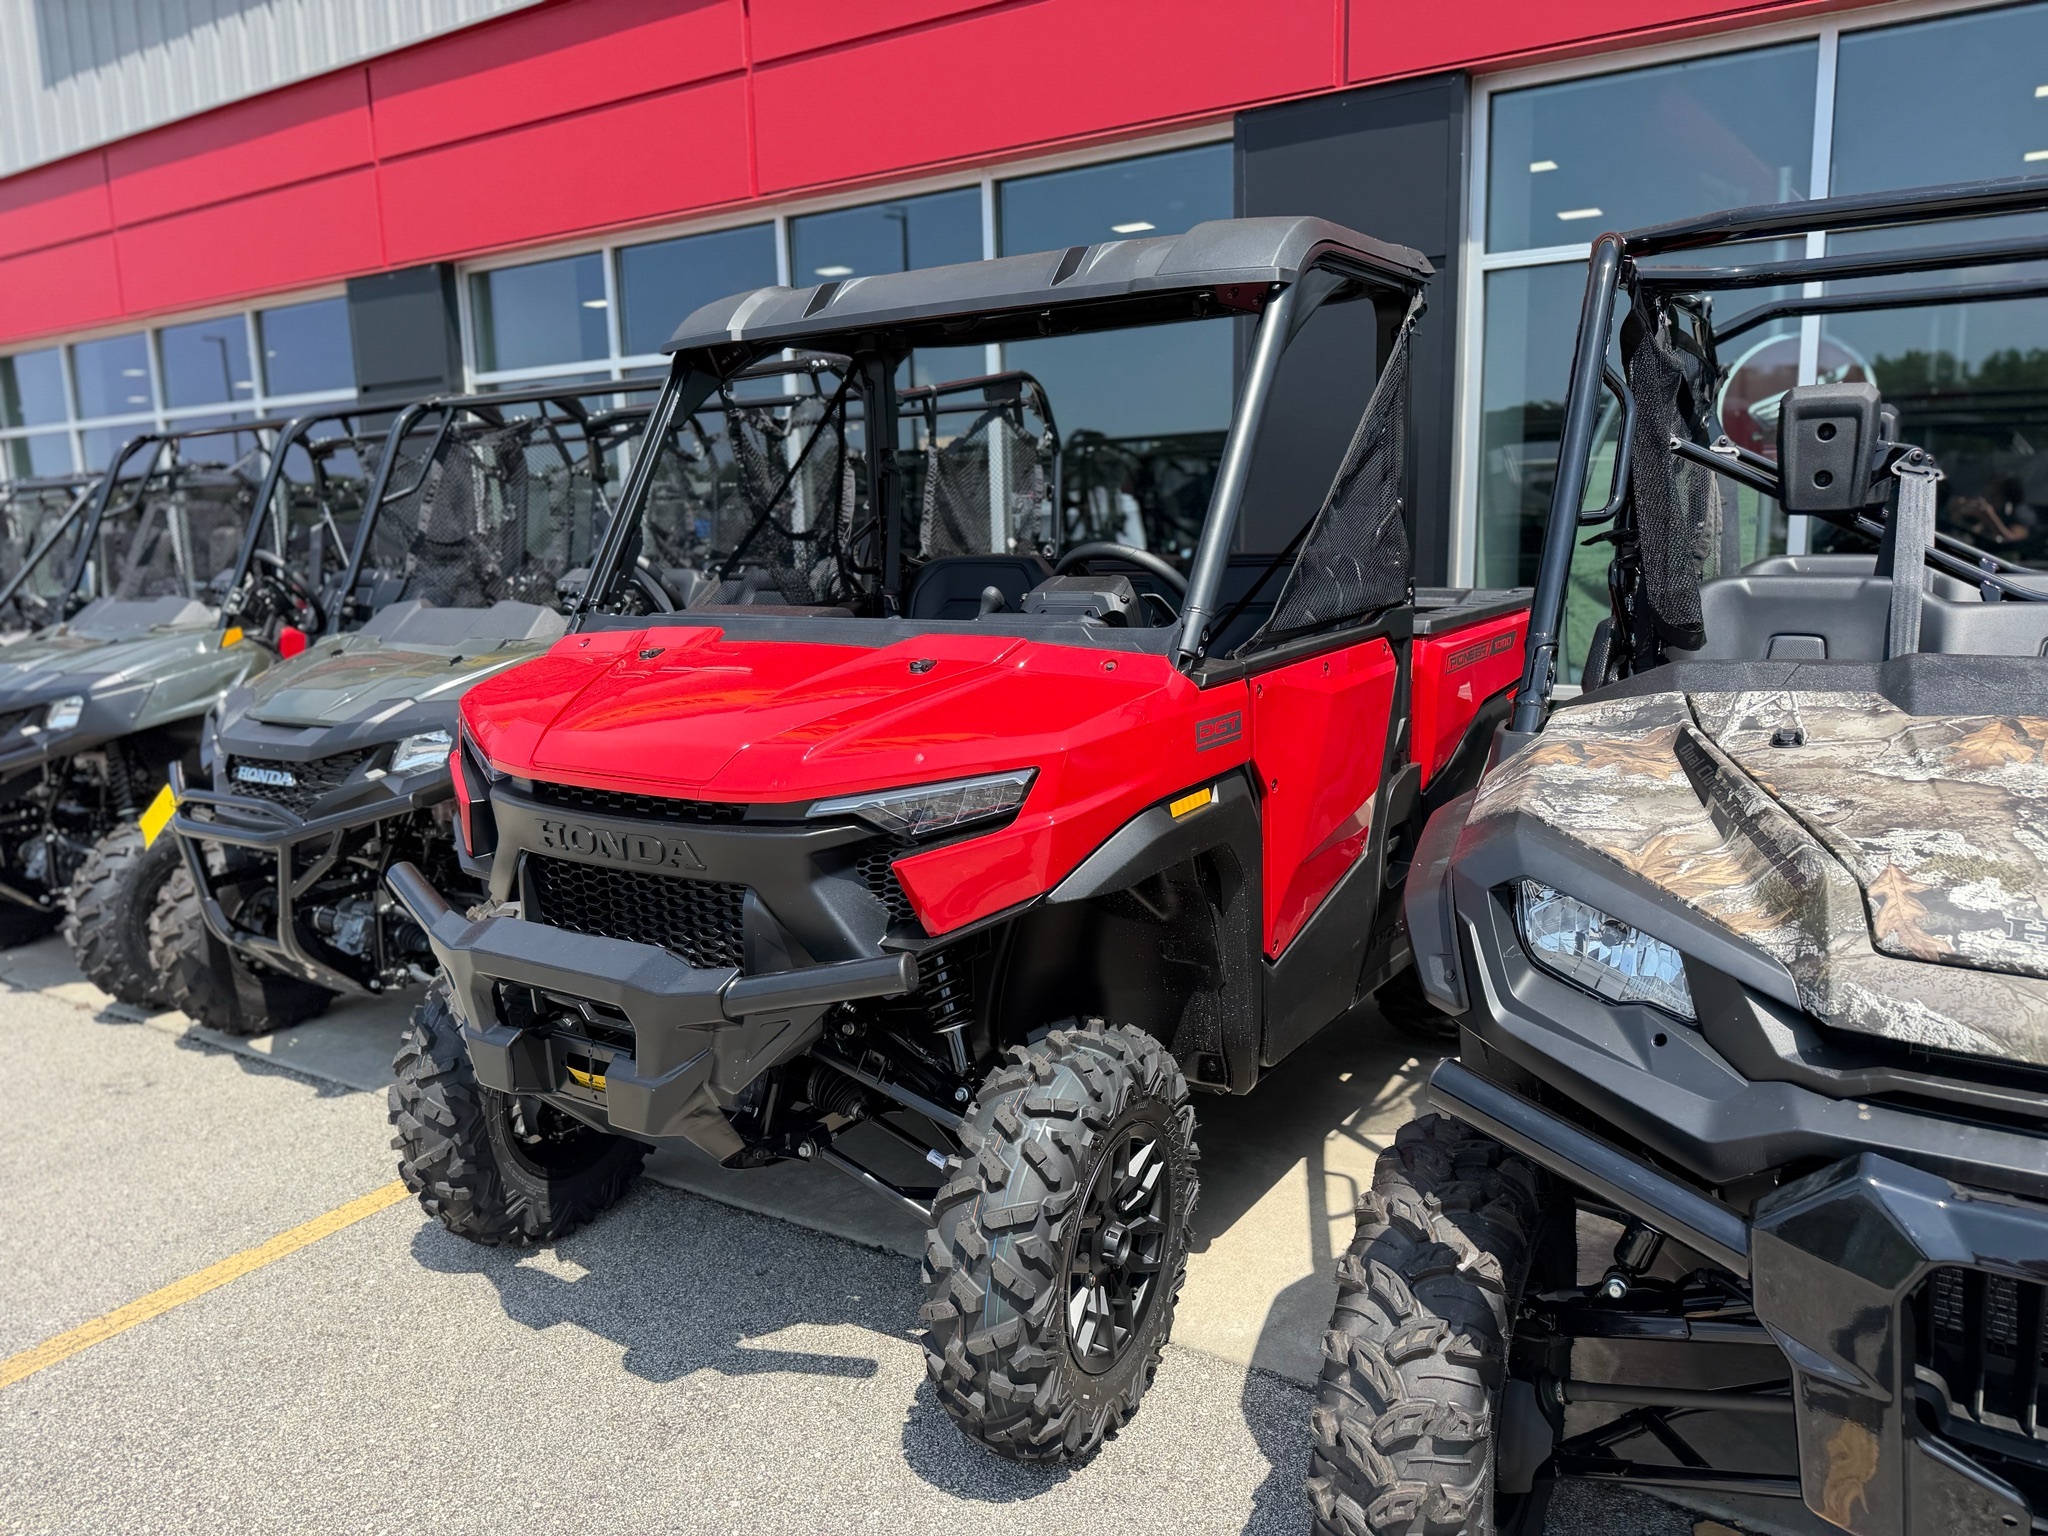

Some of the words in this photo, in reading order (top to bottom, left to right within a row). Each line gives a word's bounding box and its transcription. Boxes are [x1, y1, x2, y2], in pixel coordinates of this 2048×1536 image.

[1450, 643, 1487, 668] PIONEER
[1494, 636, 1513, 651] 1000
[1199, 715, 1240, 739] DCT
[237, 765, 297, 787] HONDA
[1679, 742, 1701, 769] Dual
[1696, 764, 1730, 803] Clutch
[1723, 795, 1807, 887] Transmission
[534, 817, 708, 872] HONDA
